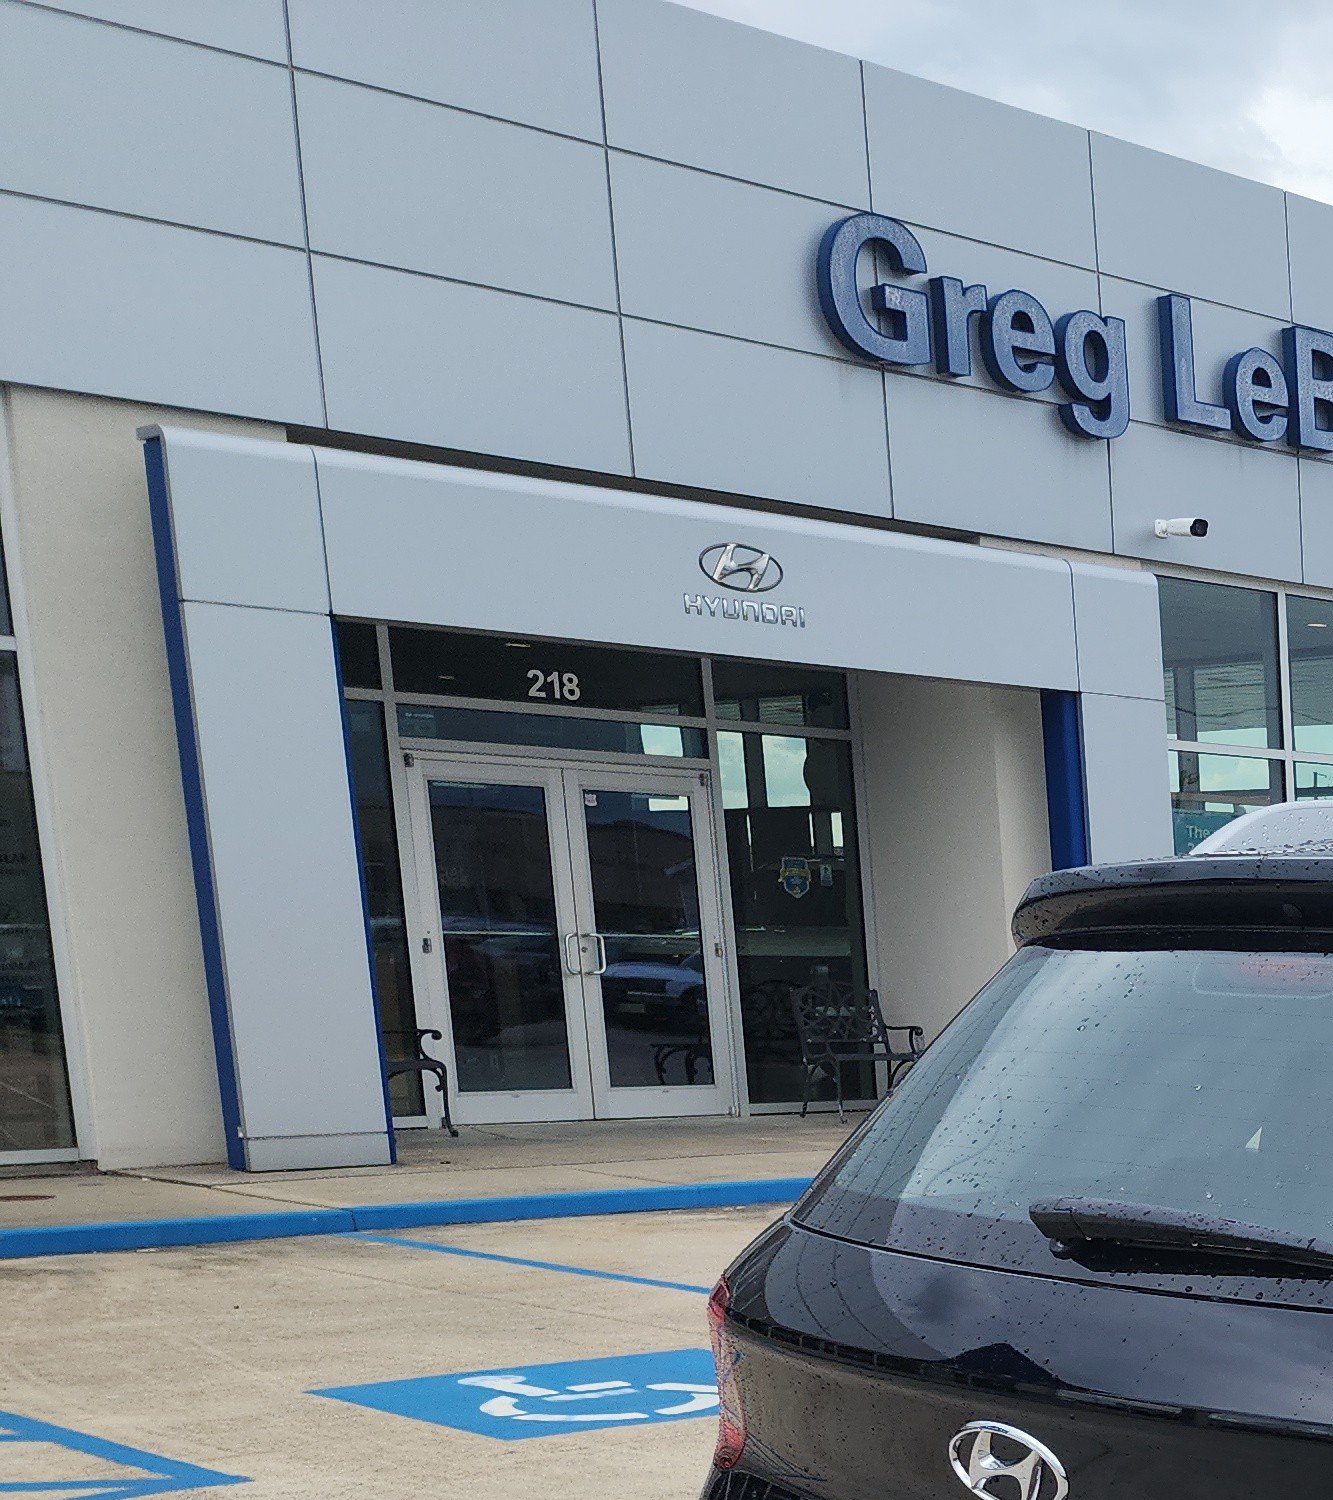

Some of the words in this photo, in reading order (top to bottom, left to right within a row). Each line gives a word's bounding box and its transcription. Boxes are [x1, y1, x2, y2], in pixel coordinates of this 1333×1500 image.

[817, 212, 1130, 439] Greg
[683, 592, 806, 628] HYUNDAI
[526, 669, 581, 701] 218
